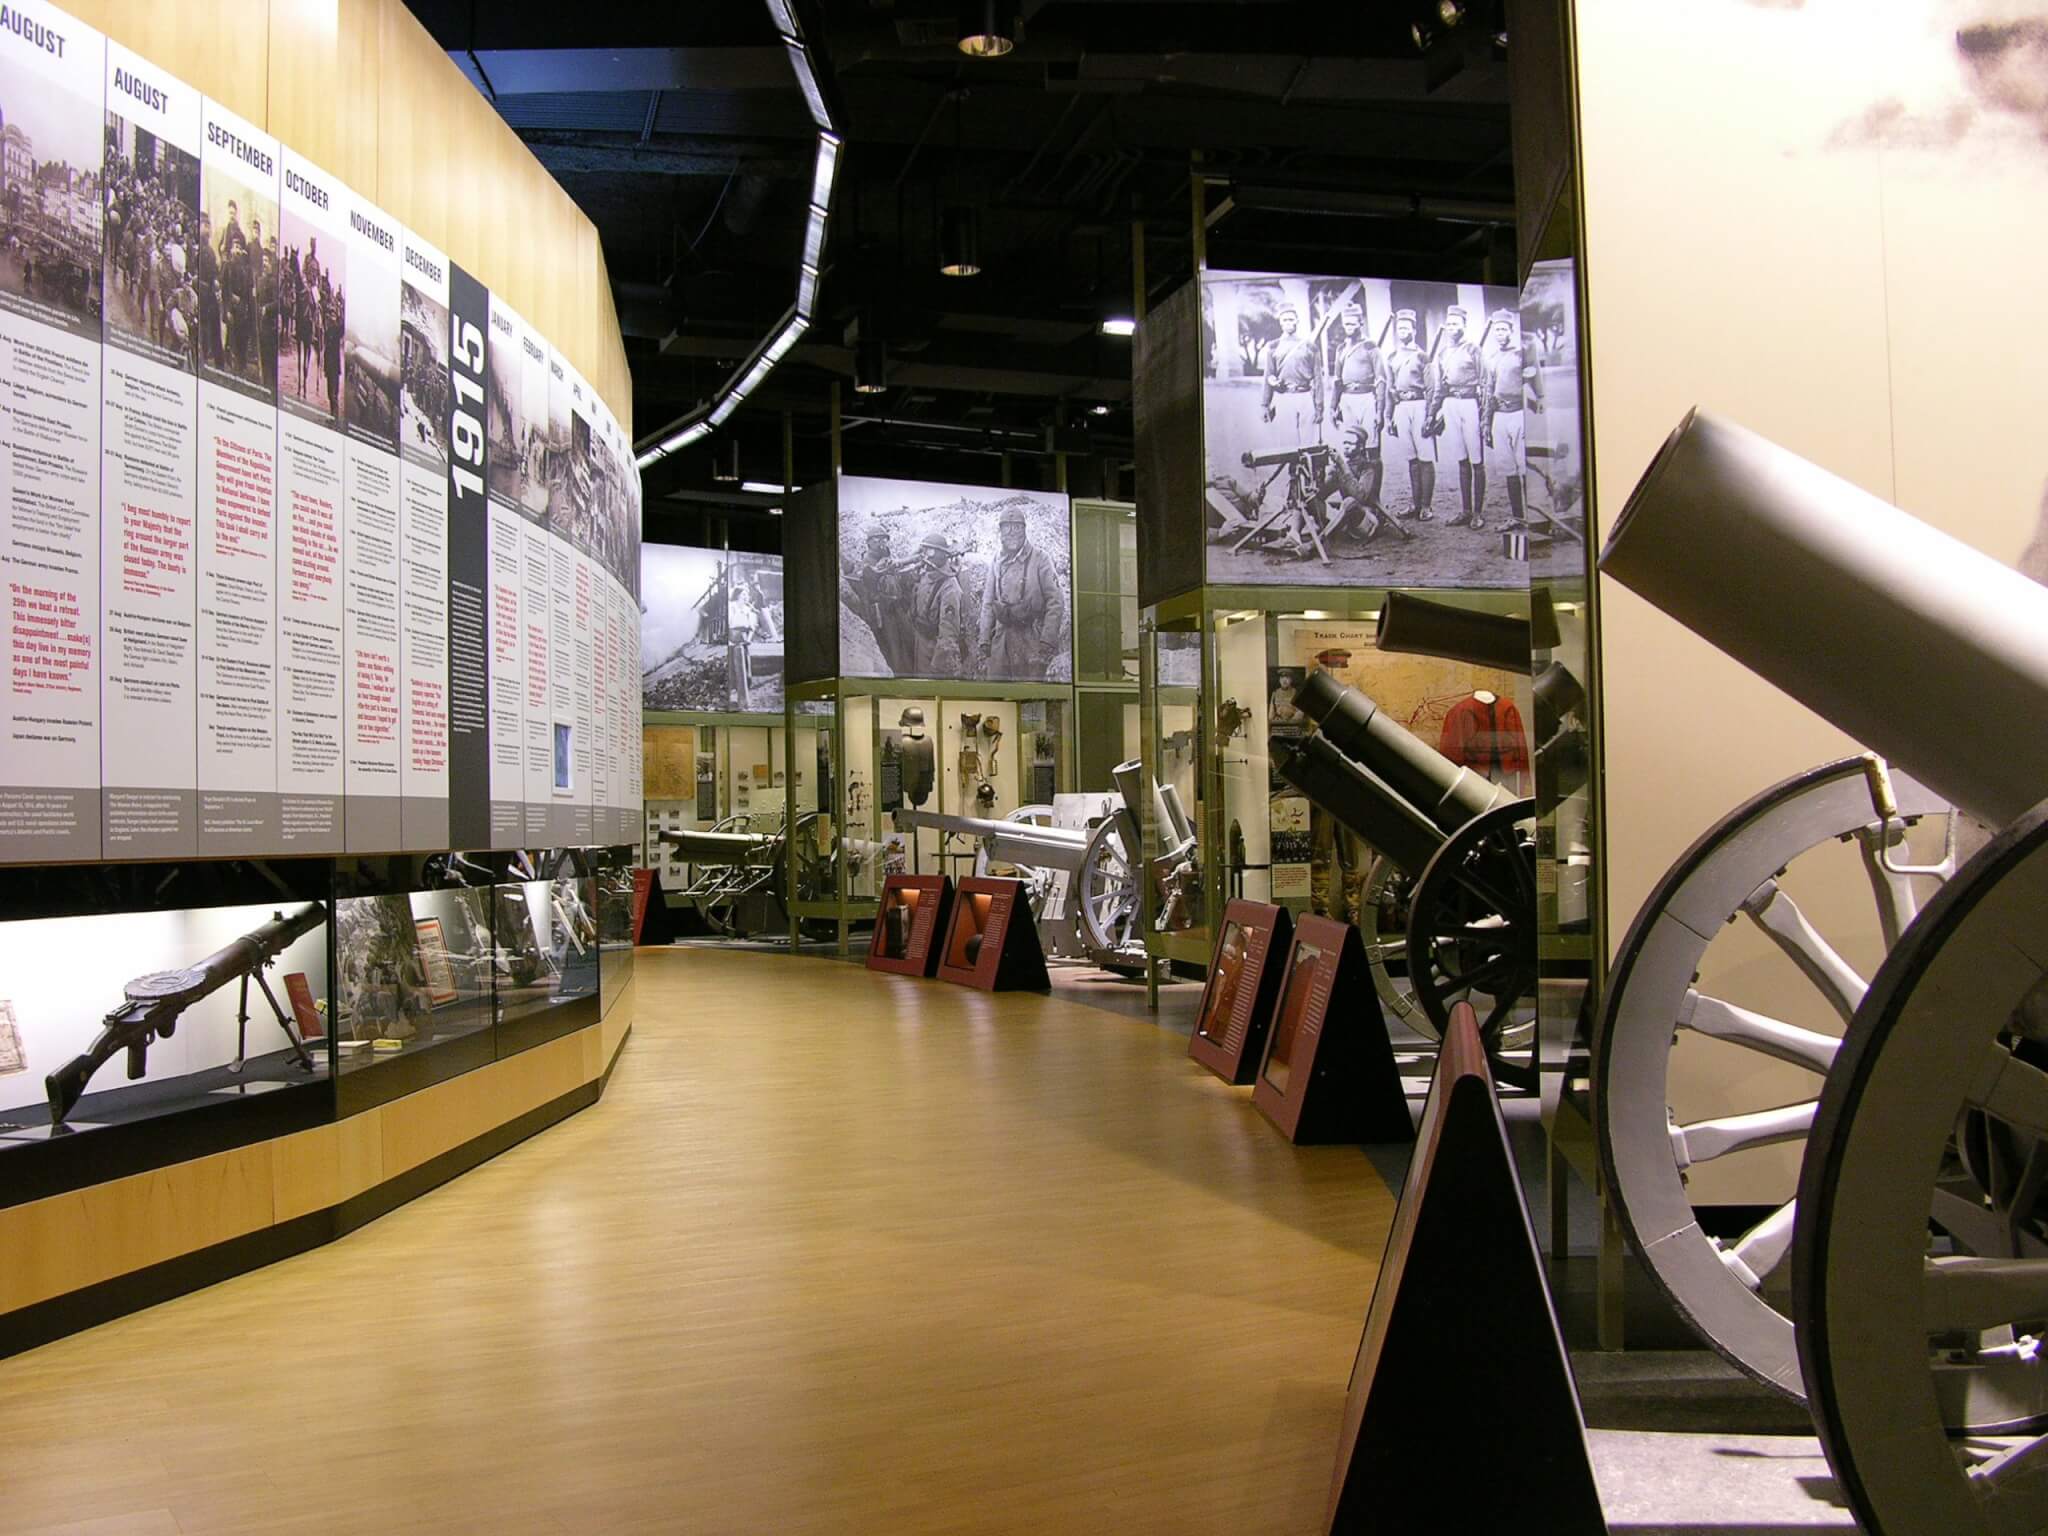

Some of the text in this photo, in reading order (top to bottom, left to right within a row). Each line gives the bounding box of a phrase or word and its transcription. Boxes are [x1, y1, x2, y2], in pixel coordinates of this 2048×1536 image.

[0, 4, 65, 59] AUGUST
[114, 67, 169, 115] AUGUST
[208, 121, 274, 178] SEPTEMBER
[286, 170, 329, 211] OCTOBER
[351, 210, 394, 253] NOVEMBER
[405, 246, 442, 284] DECEMBER
[453, 314, 484, 499] 1915
